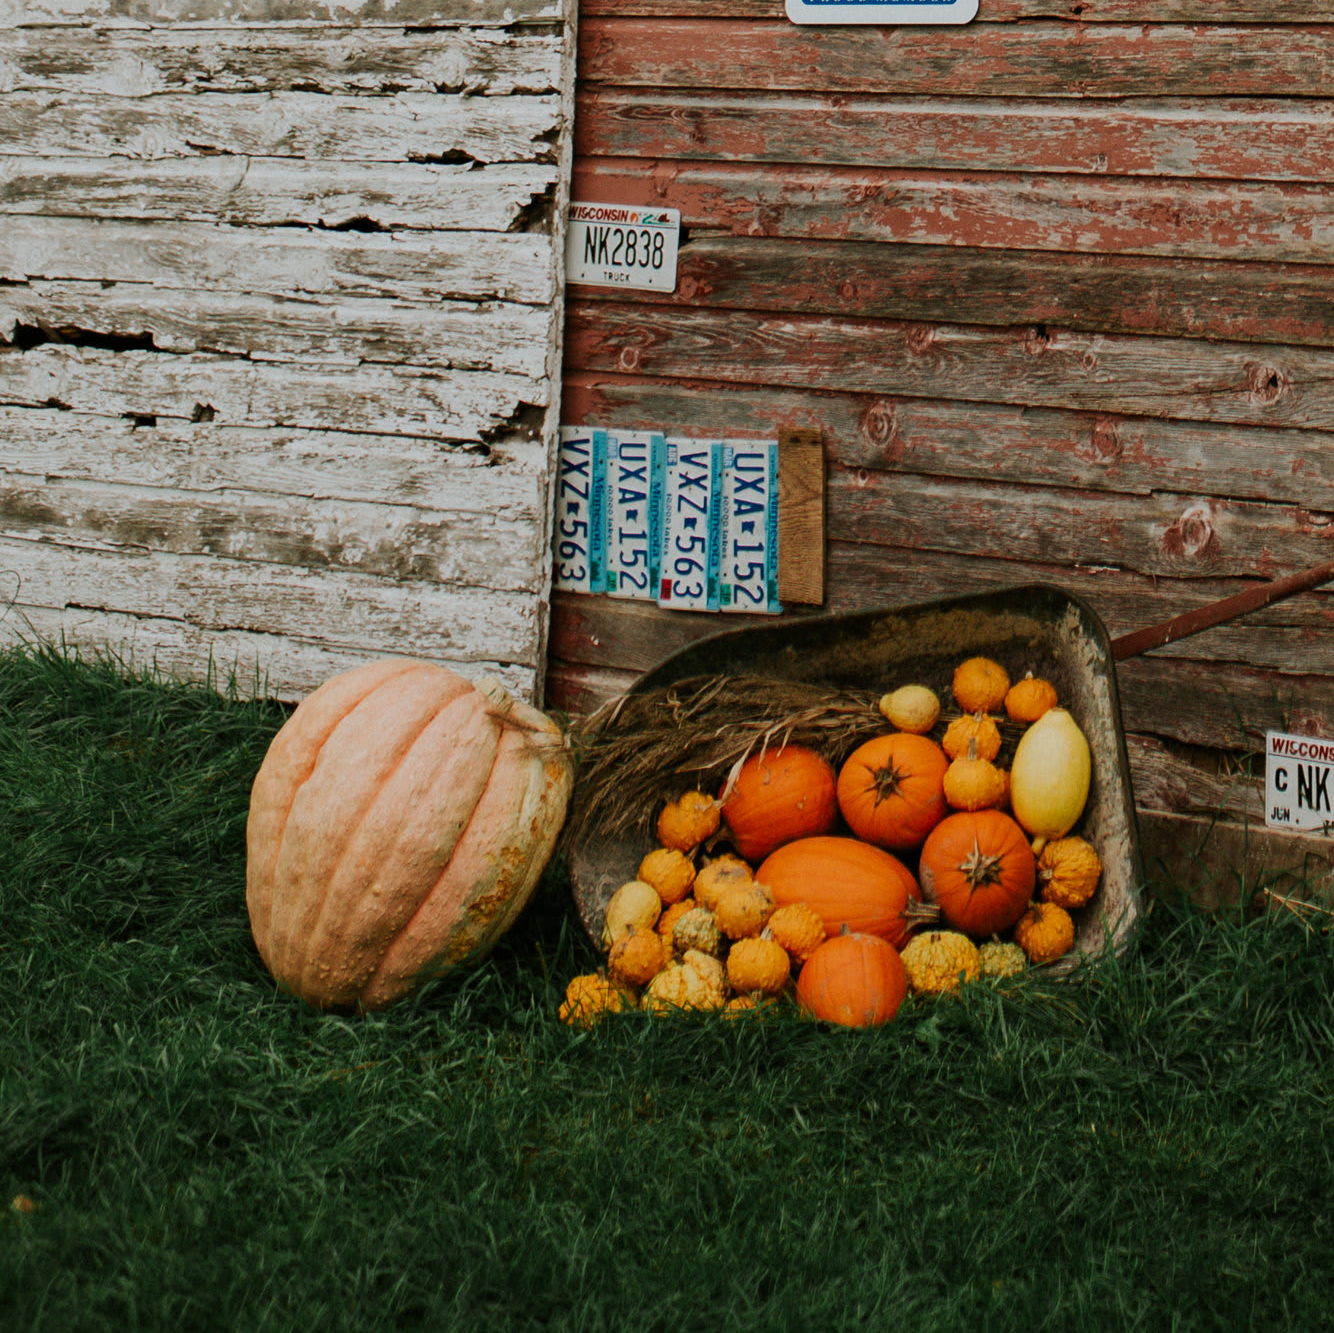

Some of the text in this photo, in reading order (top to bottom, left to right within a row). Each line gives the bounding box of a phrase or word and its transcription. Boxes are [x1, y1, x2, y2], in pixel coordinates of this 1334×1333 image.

[568, 205, 630, 223] WISCONSIN
[584, 225, 665, 270] NK2838
[603, 271, 631, 283] TRUCK
[559, 438, 590, 582] VXZ 563
[594, 476, 604, 551] Minnesota
[618, 442, 649, 590] UXA 152
[652, 482, 662, 557] Minnesota
[673, 451, 709, 599] VXZ 563
[711, 490, 720, 567] Minnesota
[733, 453, 765, 604] UXA 152
[1270, 805, 1291, 822] JUN
[1274, 767, 1288, 792] C
